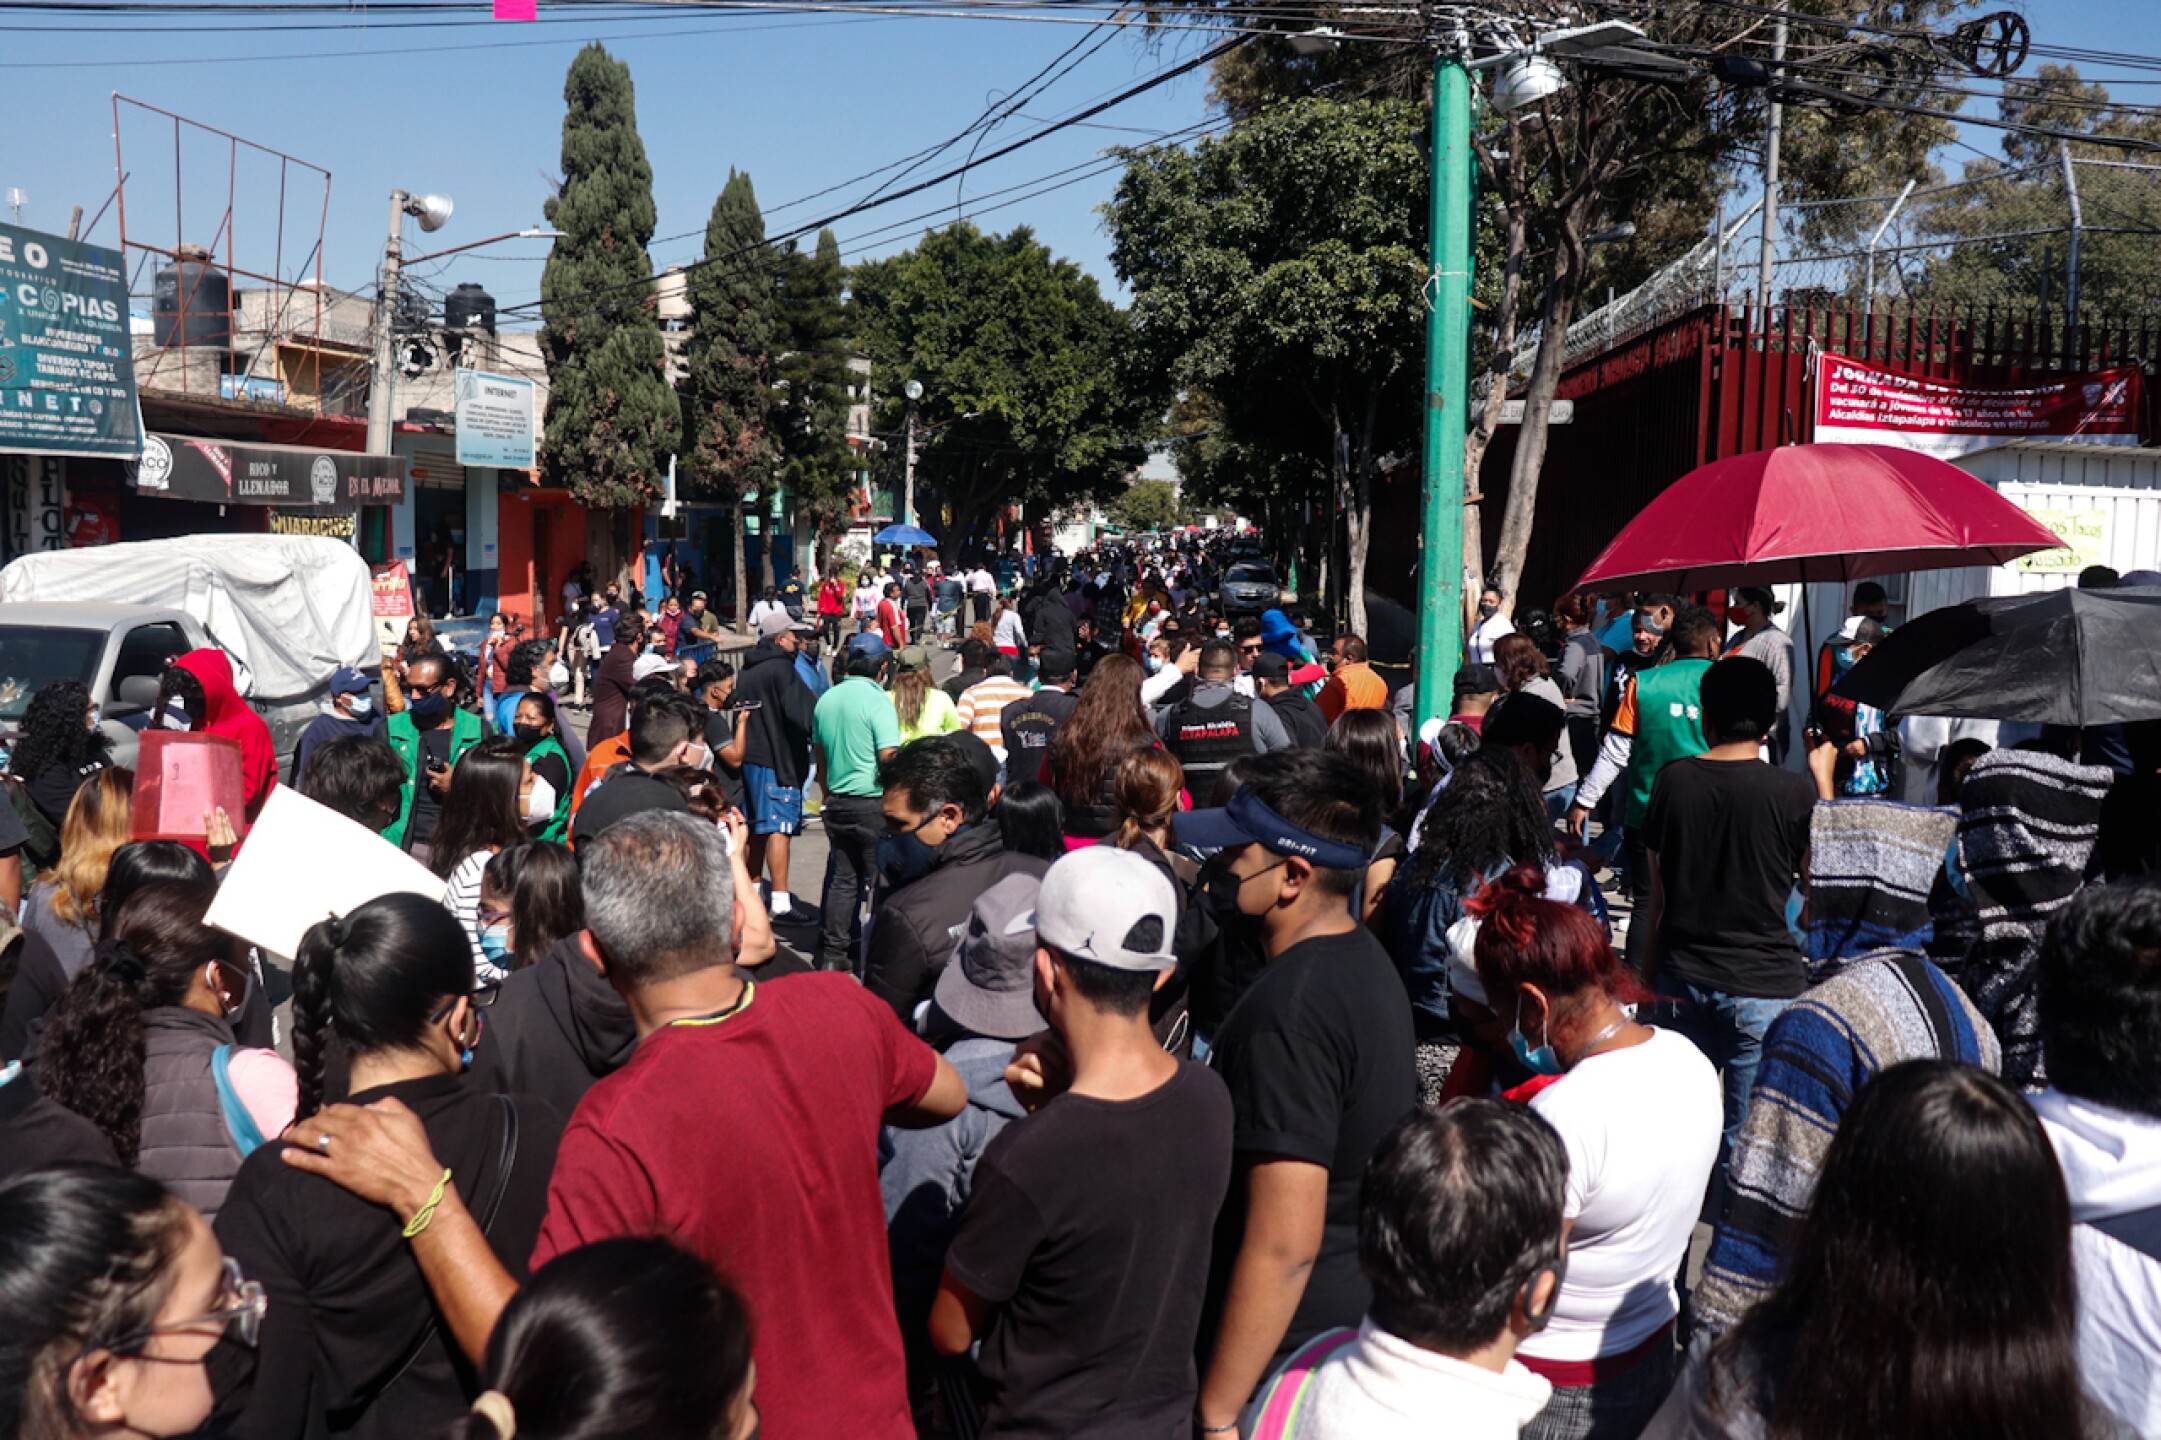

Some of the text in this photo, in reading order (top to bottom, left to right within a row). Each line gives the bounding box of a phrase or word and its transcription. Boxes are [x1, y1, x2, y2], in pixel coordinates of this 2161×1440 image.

[1831, 365, 1919, 390] JORNADA
[1829, 382, 1849, 394] Del
[1850, 383, 1868, 396] 30
[0, 389, 82, 413] NET
[1829, 396, 1878, 409] vacunará
[1878, 400, 1888, 410] a
[249, 462, 278, 477] RICO Y
[238, 479, 290, 496] LLENADOR
[271, 513, 355, 536] HUARACHES
[1277, 836, 1318, 857] DRI-FIT
